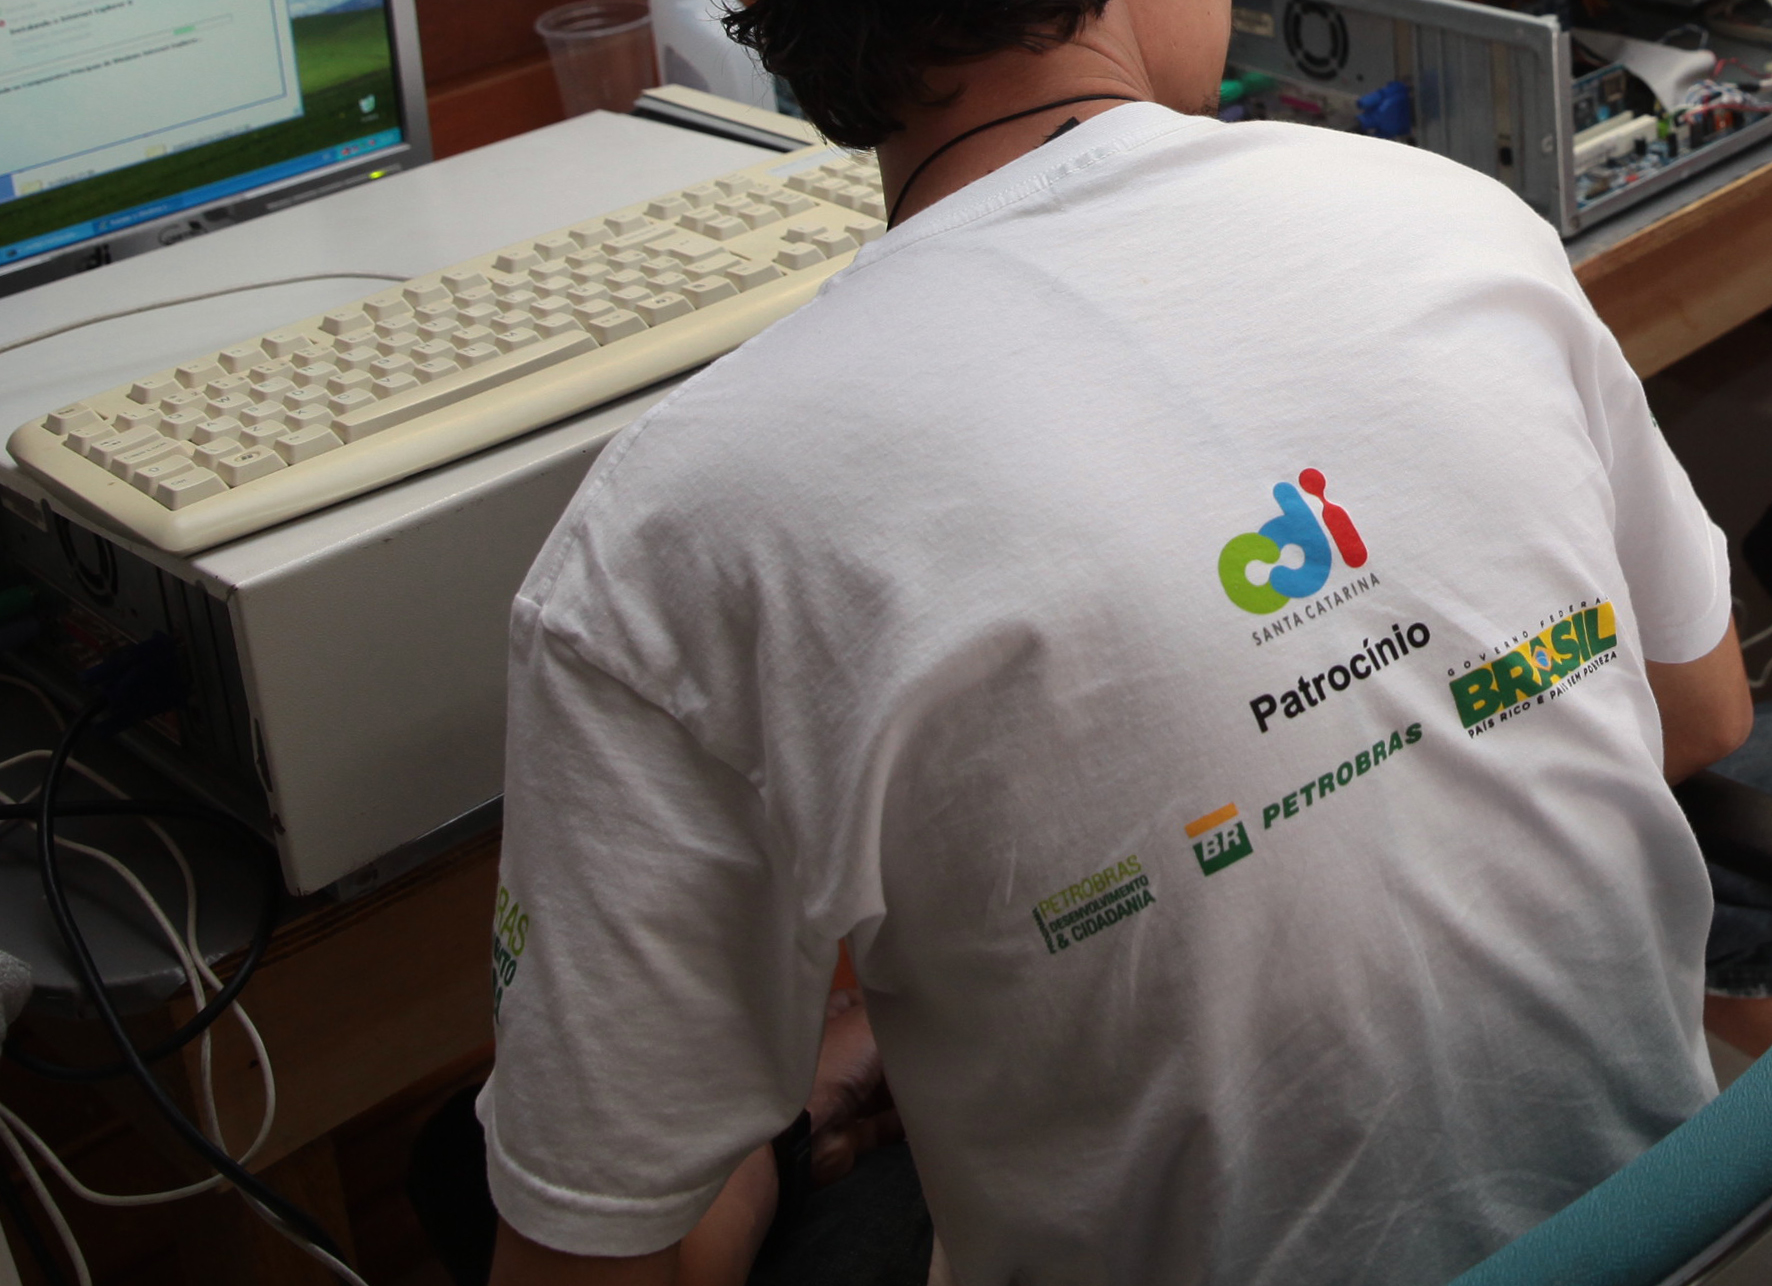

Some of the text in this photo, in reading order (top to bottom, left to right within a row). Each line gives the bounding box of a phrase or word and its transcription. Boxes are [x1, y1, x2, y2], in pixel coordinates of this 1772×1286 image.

[1252, 573, 1380, 646] SANTA CATARINA
[1447, 597, 1609, 677] GOVERNO FEDERA
[1249, 620, 1432, 733] Patrocínio
[1449, 601, 1617, 729] BRASIL
[1467, 717, 1495, 740] PAÍS
[1500, 701, 1531, 723] RICO
[1261, 722, 1424, 830] PETROBRAS
[1200, 821, 1242, 864] BR
[1039, 854, 1143, 917] PETROBRAS
[1048, 874, 1150, 935] DESENVOLVIMENTO
[1054, 930, 1071, 952] &
[1070, 888, 1157, 945] CIDADANIA
